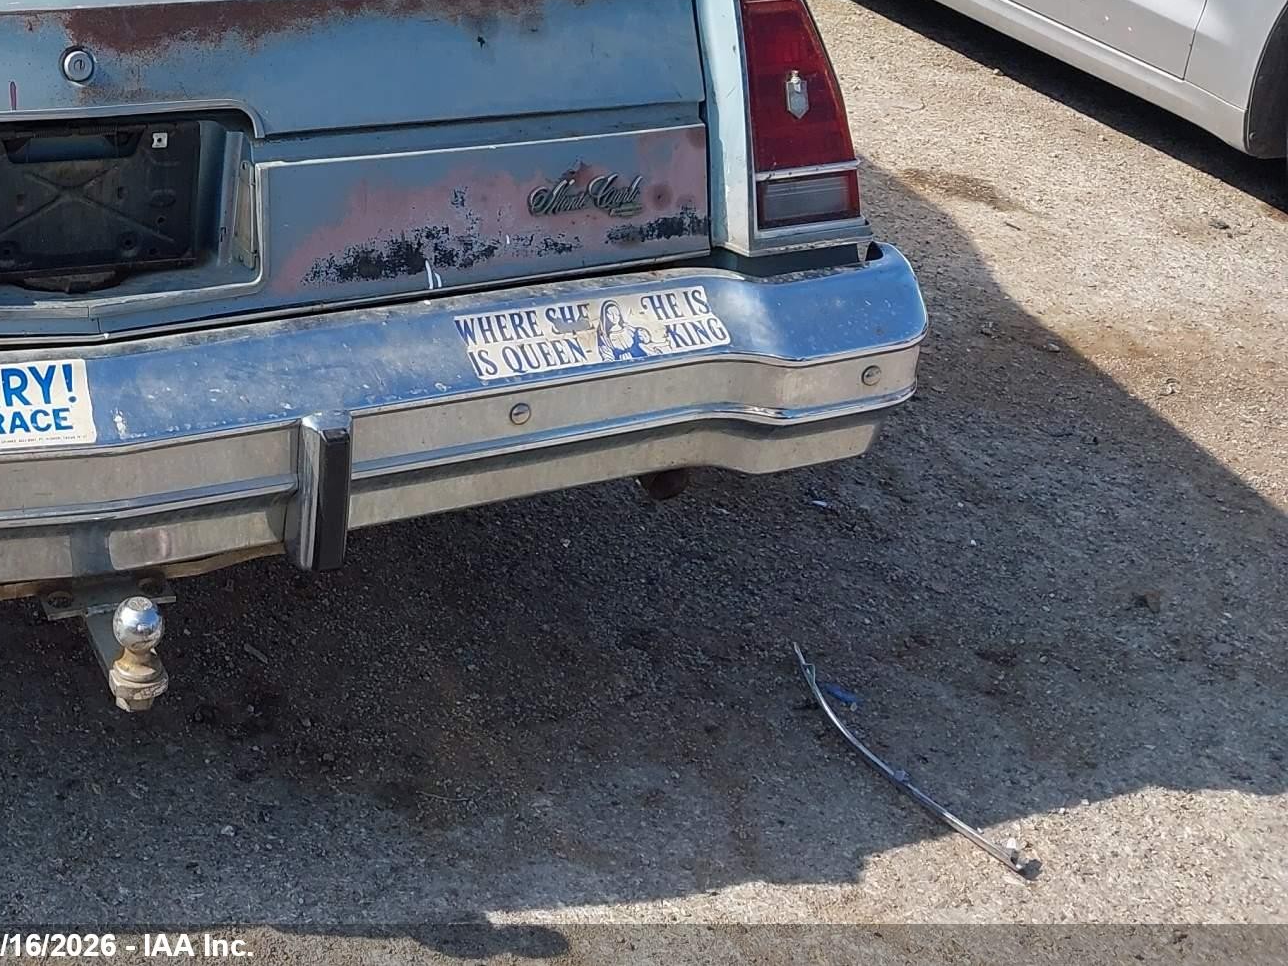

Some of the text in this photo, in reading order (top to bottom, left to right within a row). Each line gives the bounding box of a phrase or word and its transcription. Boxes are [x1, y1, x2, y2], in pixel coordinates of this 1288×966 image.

[641, 289, 710, 321] HE IS
[454, 310, 543, 346] WHERE
[664, 318, 727, 349] KING
[468, 348, 498, 377] IS
